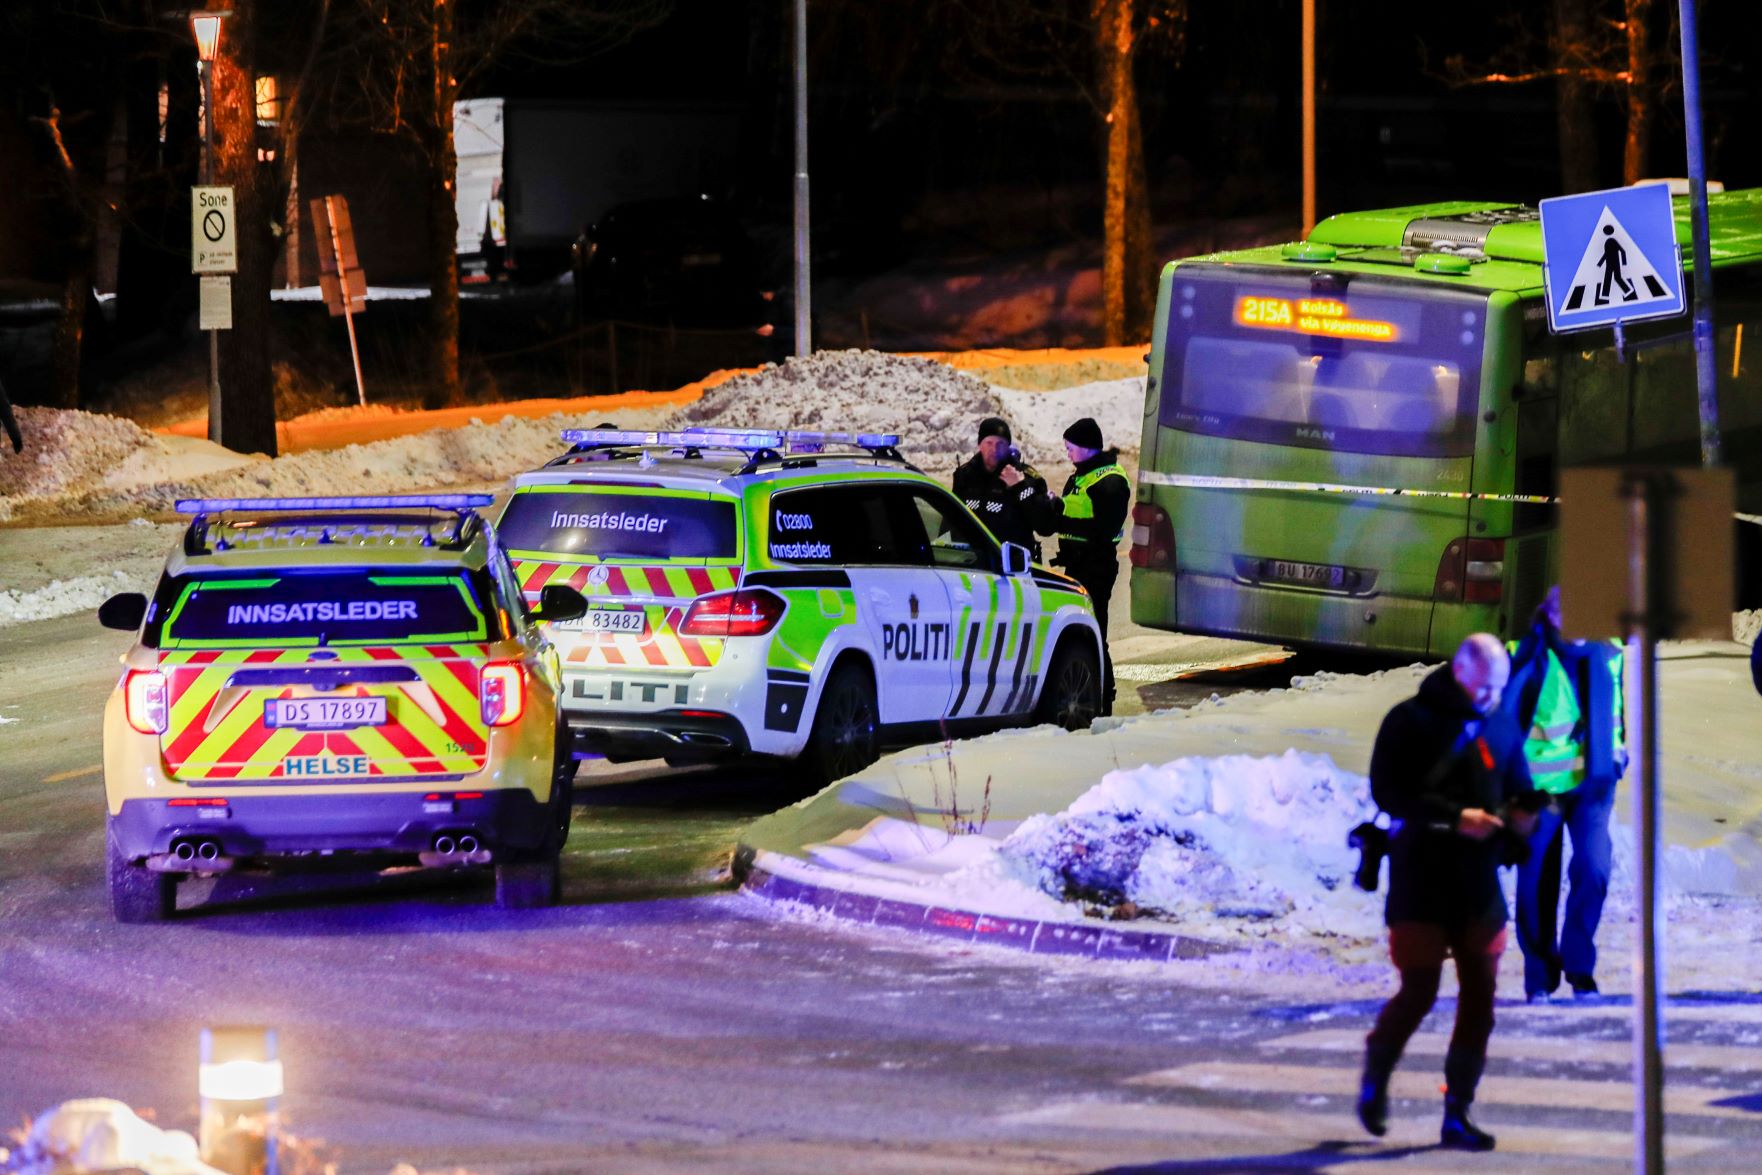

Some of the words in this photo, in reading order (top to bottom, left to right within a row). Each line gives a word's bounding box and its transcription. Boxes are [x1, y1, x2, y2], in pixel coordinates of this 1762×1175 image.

[199, 192, 228, 207] Sone
[1243, 298, 1292, 325] 215A
[1300, 316, 1320, 329] via
[1296, 428, 1336, 441] MAN
[550, 510, 668, 534] Innsatsleder
[782, 513, 813, 530] 02800
[769, 540, 832, 559] Innsatsleder
[227, 600, 418, 625] INNSATSLEDER
[592, 612, 641, 629] 83482
[882, 622, 950, 661] POLITI
[572, 679, 689, 705] LITI
[285, 703, 310, 721] DS
[319, 701, 378, 720] 17897
[285, 756, 369, 775] HELSE
